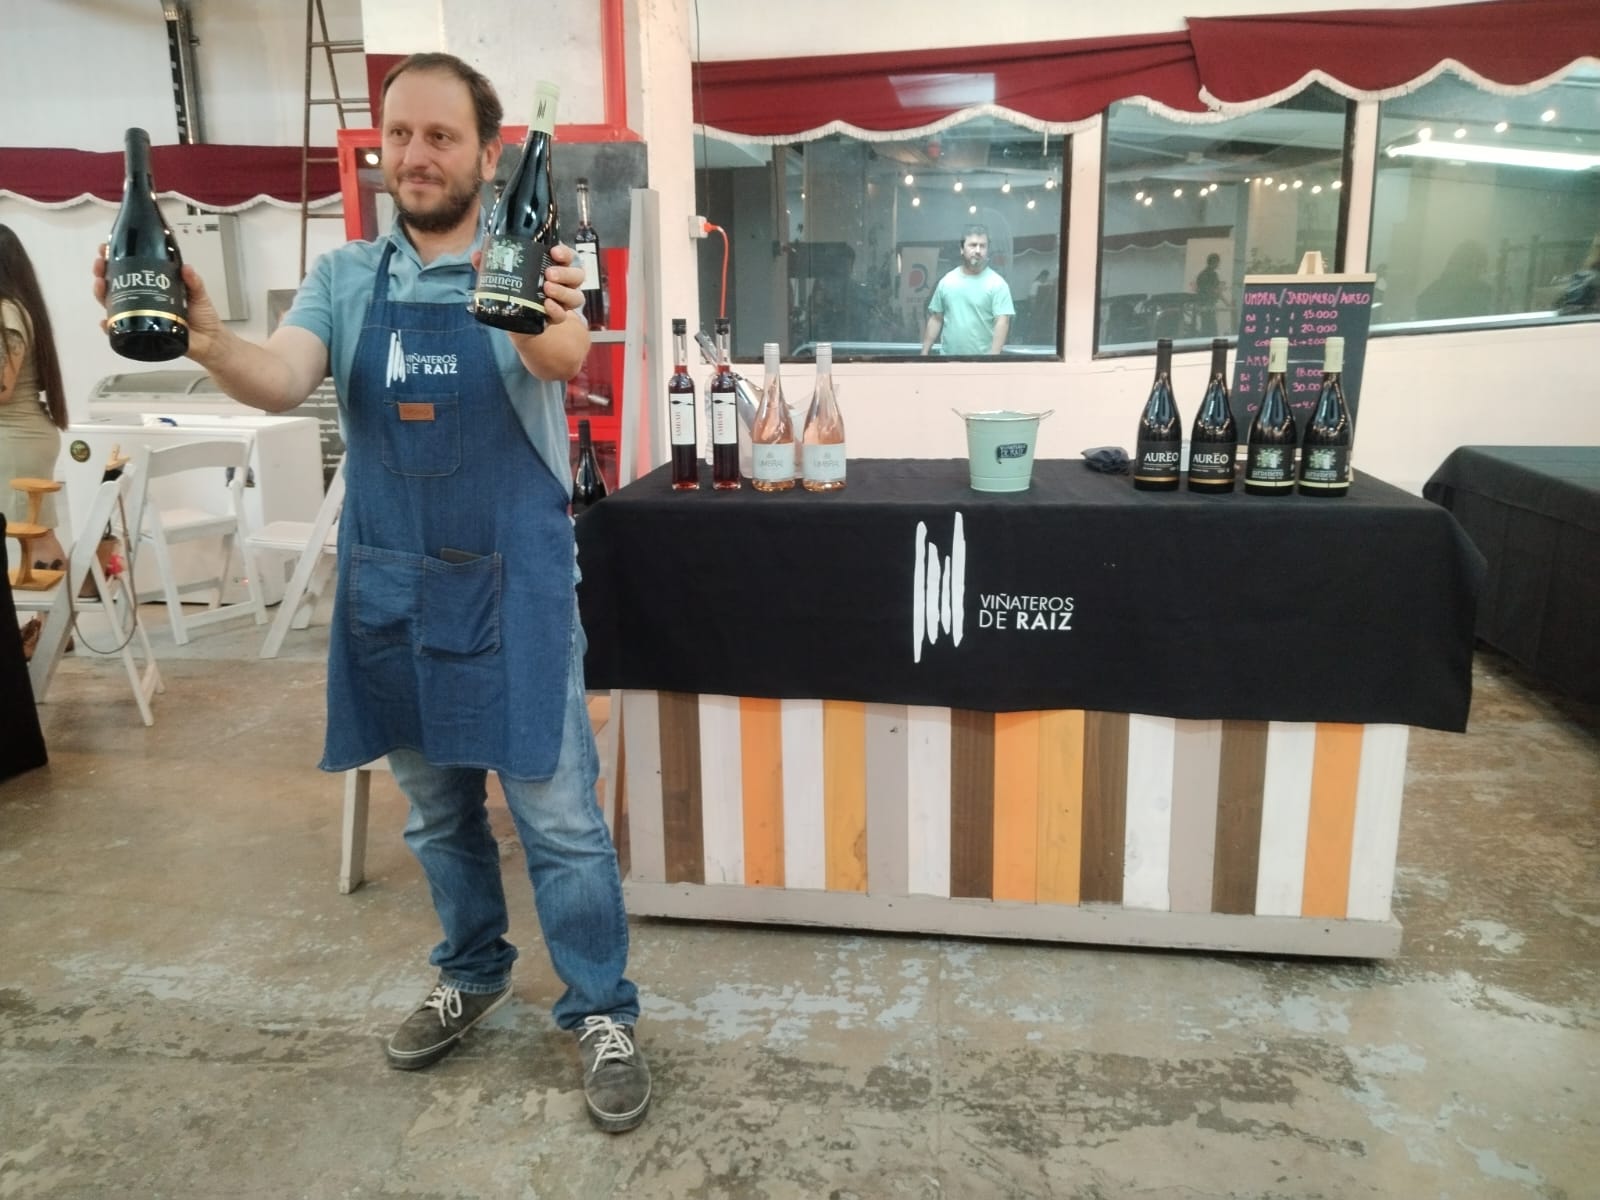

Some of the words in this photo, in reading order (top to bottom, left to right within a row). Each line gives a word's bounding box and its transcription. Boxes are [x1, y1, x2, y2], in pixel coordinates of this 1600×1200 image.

[424, 363, 458, 375] RAIZ
[1143, 452, 1180, 463] AUREO
[1193, 453, 1230, 465] AUREO
[979, 593, 1075, 612] VIÑATEROS
[978, 609, 1008, 629] DE
[1015, 611, 1073, 631] RAIZ
